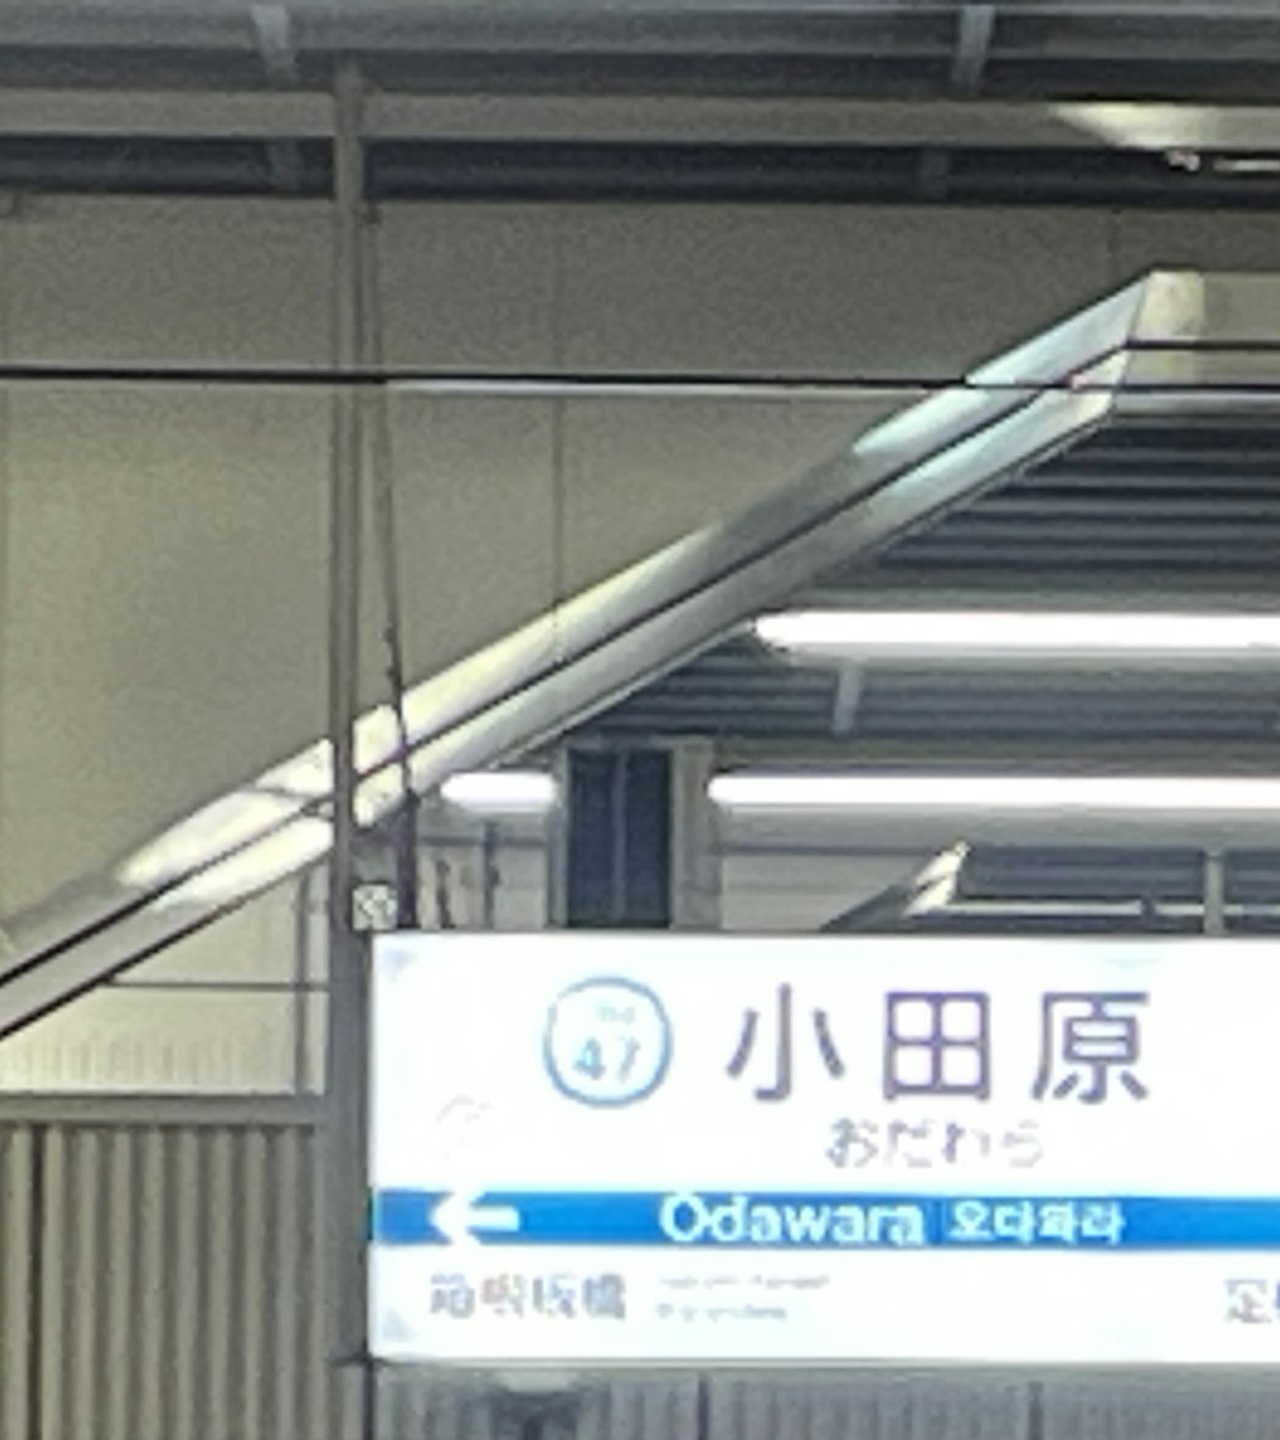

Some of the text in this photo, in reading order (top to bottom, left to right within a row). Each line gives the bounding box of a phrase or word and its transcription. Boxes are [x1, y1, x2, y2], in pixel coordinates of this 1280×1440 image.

[725, 983, 1150, 1105] 小田原
[824, 1117, 1046, 1170] おだわら
[658, 1191, 925, 1245] Odawara
